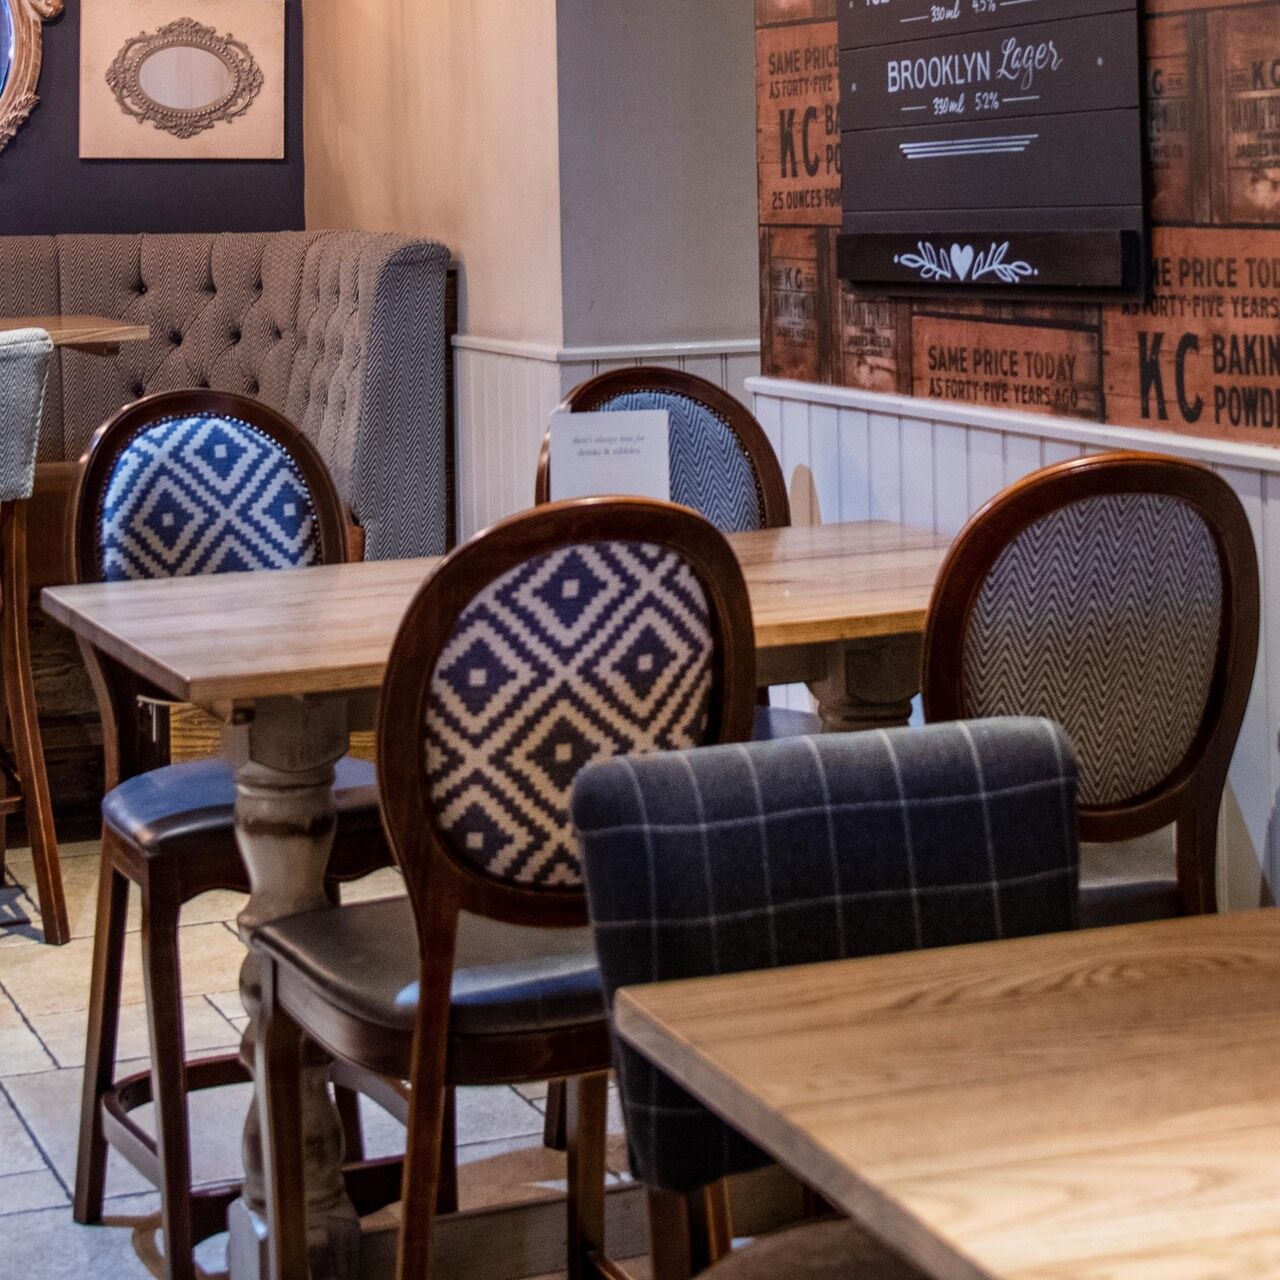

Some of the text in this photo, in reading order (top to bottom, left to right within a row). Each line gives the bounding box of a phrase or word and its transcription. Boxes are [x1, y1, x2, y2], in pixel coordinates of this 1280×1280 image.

[887, 36, 1064, 94] BROOKLYN Lager
[1178, 257, 1237, 288] PRICE
[1230, 296, 1279, 319] YEARS
[927, 345, 1078, 383] SAME PRICE TODAY
[928, 377, 942, 397] AS
[1013, 385, 1051, 406] YEARS
[1052, 387, 1078, 409] AGO
